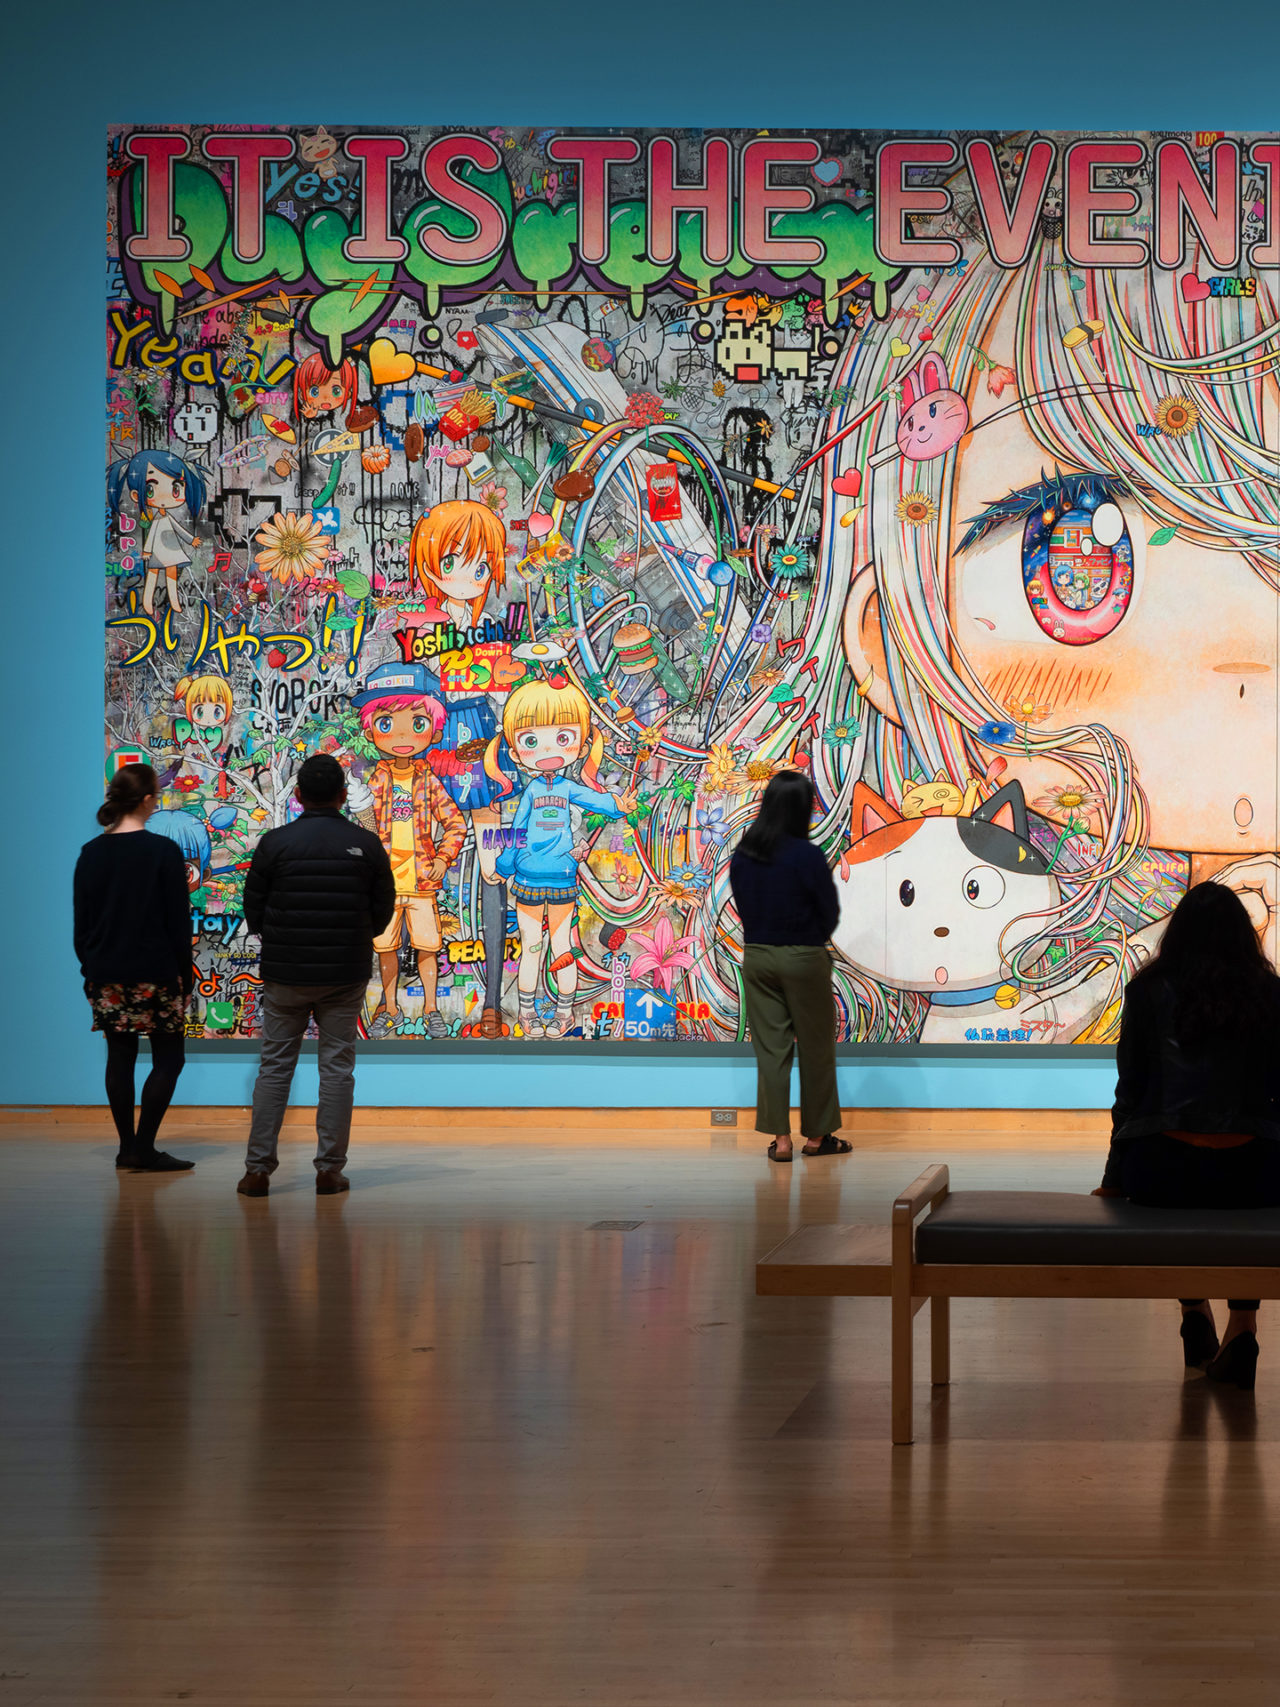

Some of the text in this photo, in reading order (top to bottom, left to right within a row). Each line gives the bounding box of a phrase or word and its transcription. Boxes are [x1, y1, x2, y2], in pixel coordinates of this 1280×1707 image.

[125, 132, 297, 263] IT
[341, 132, 508, 266] IS
[546, 134, 827, 267] THE
[1208, 276, 1257, 299] GIRLS
[255, 391, 289, 406] CITY
[447, 407, 467, 428] Mr.
[533, 795, 569, 812] ANARCHY
[482, 827, 528, 851] HAVE
[190, 909, 242, 946] tay
[448, 937, 522, 964] BEATY
